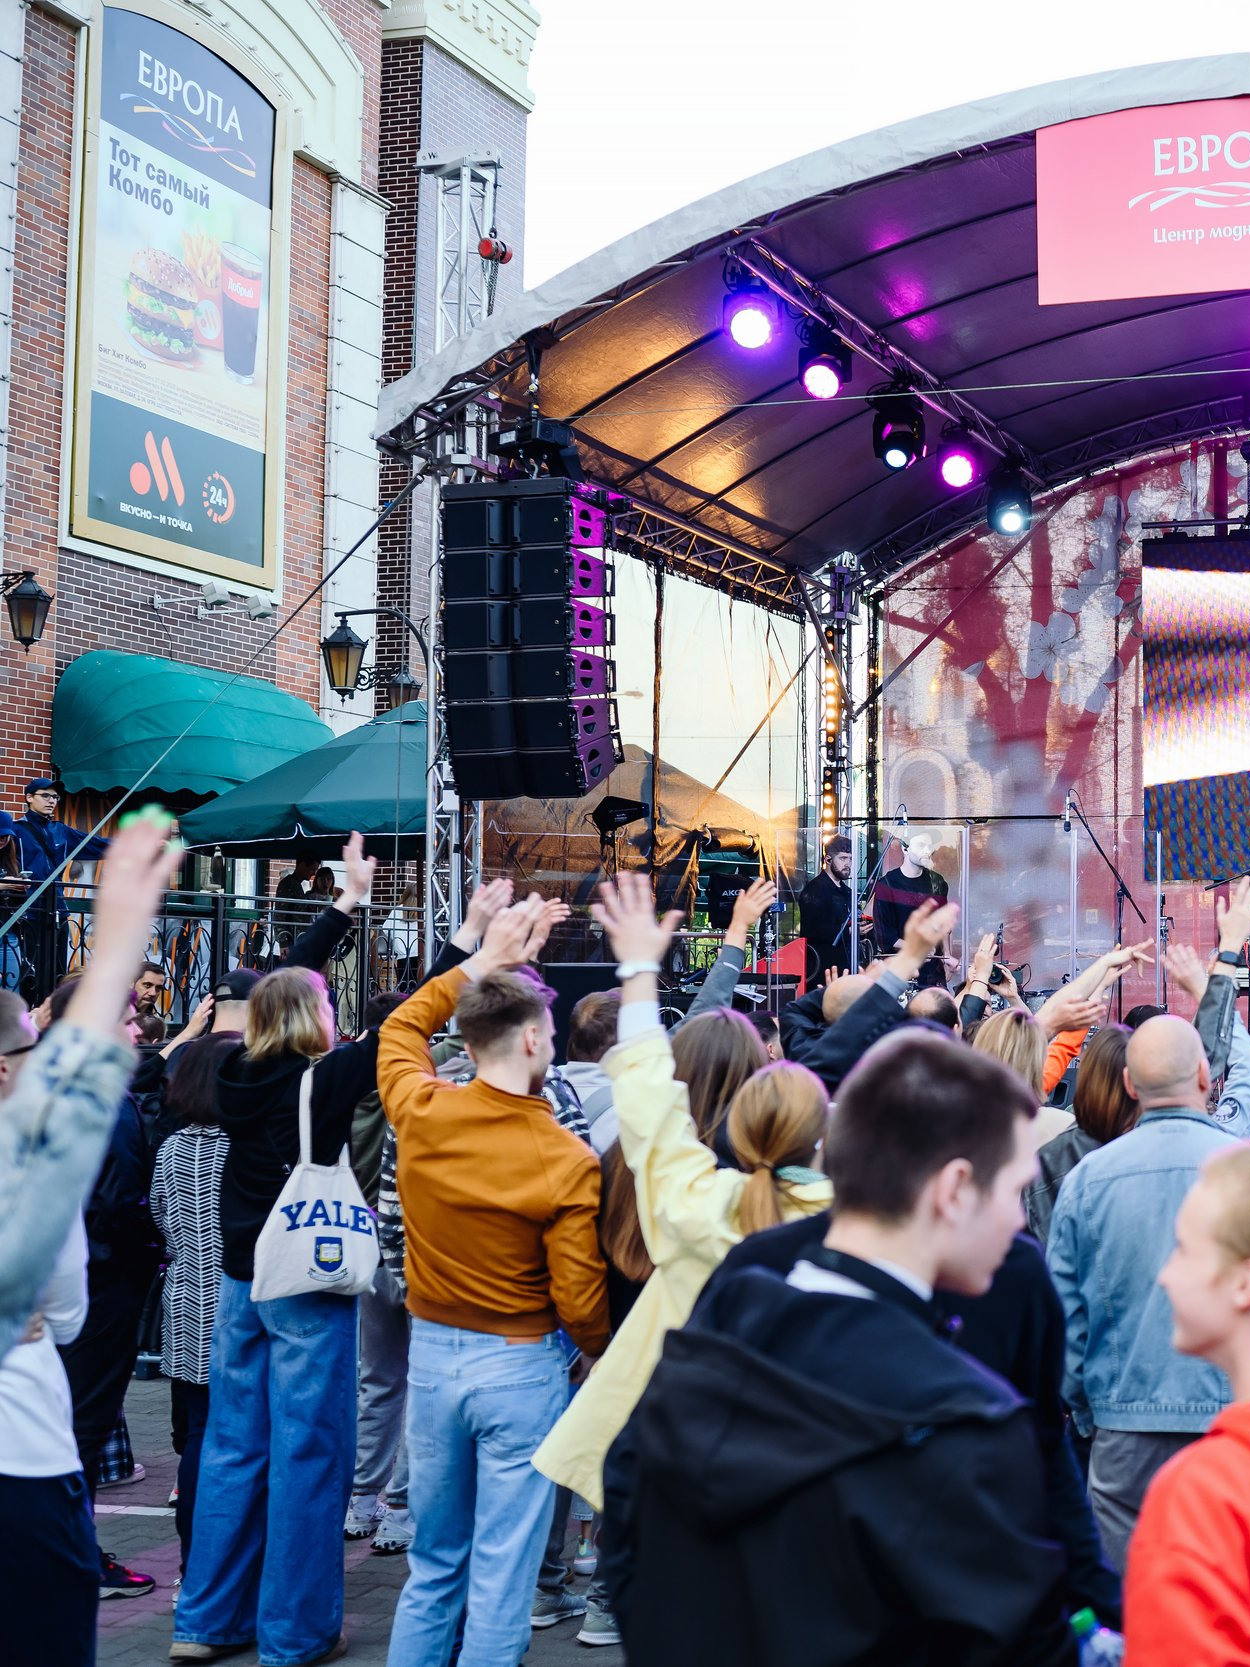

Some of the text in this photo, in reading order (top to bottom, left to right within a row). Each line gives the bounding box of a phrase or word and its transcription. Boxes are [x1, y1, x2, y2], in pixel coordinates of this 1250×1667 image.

[138, 50, 243, 141] ЕВРОПА
[109, 137, 210, 209] Тот самый
[109, 164, 174, 215] Комбо
[1153, 226, 1205, 244] Центр
[98, 343, 147, 369] Биг Хит Комбо
[120, 502, 152, 520] ВКУСНО
[167, 516, 193, 533] ТОЧКА
[280, 1199, 373, 1236] YALE
